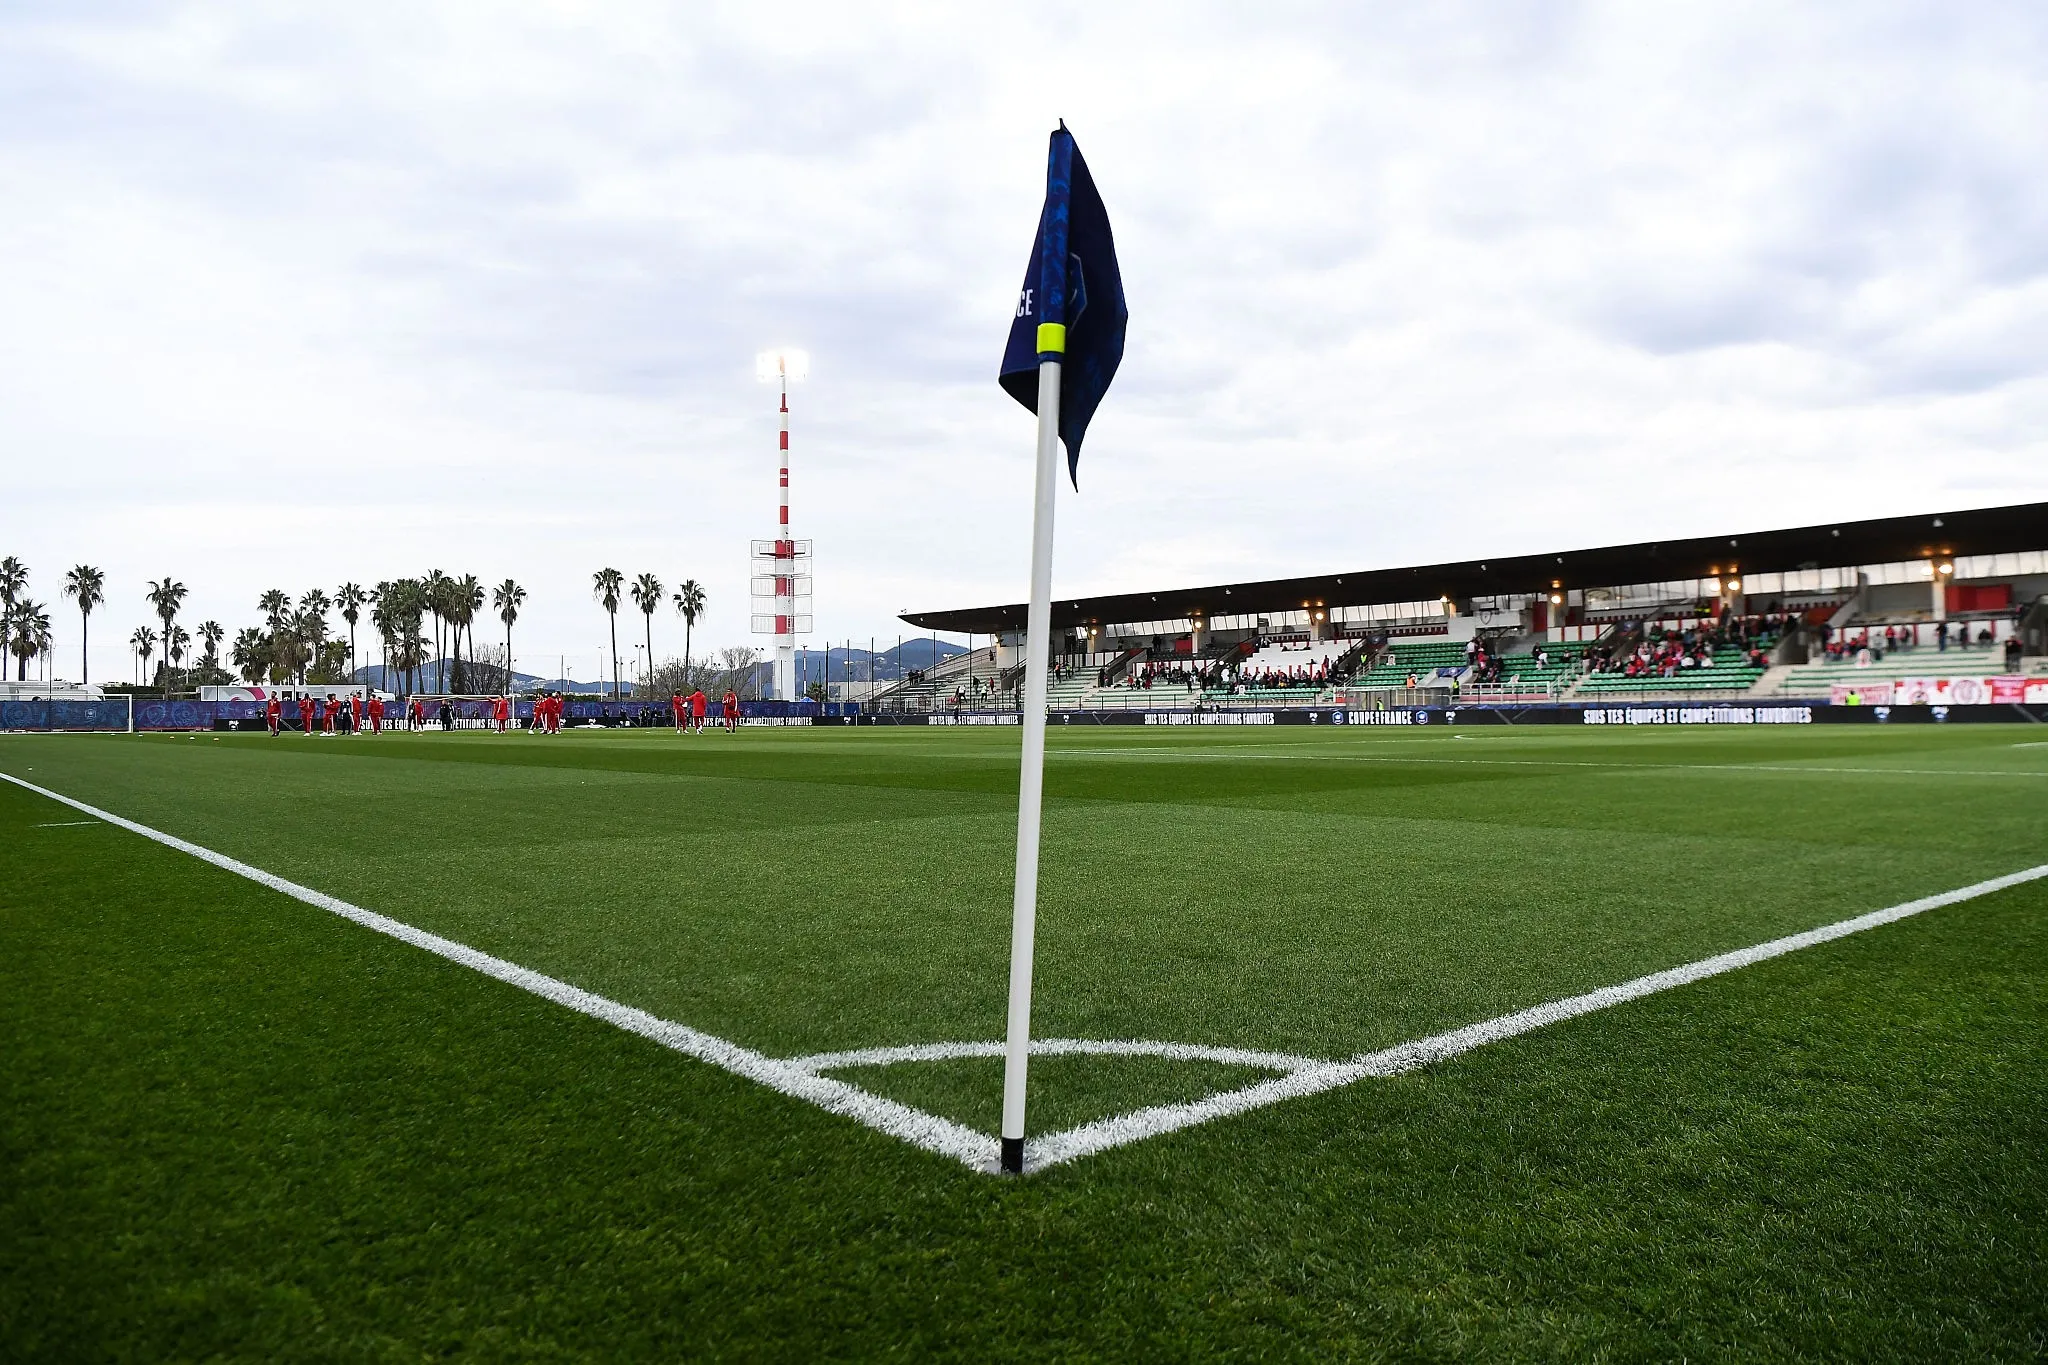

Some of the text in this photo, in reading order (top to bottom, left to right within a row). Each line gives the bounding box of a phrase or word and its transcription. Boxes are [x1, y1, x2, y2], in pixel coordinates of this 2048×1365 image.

[1144, 711, 1275, 726] SUIS TES ÉQUIPES ET COMPÉTITIONS FAVORITES
[1348, 711, 1375, 725] COUPE
[1380, 710, 1412, 725] FRANCE
[1607, 708, 1624, 724] TES
[1666, 708, 1679, 723] ET
